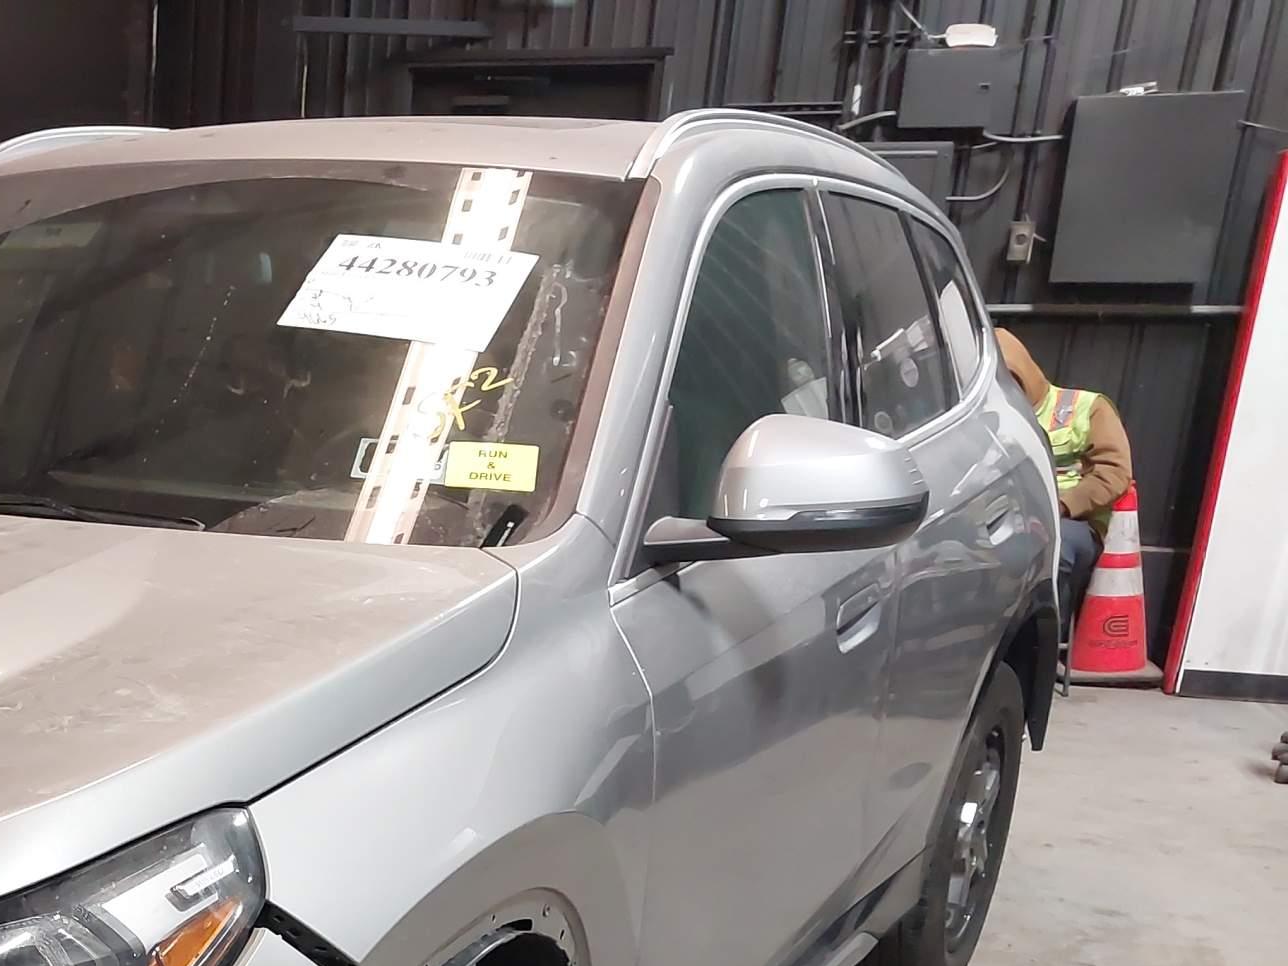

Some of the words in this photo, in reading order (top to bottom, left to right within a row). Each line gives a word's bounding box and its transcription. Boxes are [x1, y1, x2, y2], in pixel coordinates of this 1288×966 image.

[339, 255, 497, 287] 44280793
[478, 449, 508, 459] RUN
[487, 461, 496, 469] &
[469, 471, 512, 482] DRIVE
